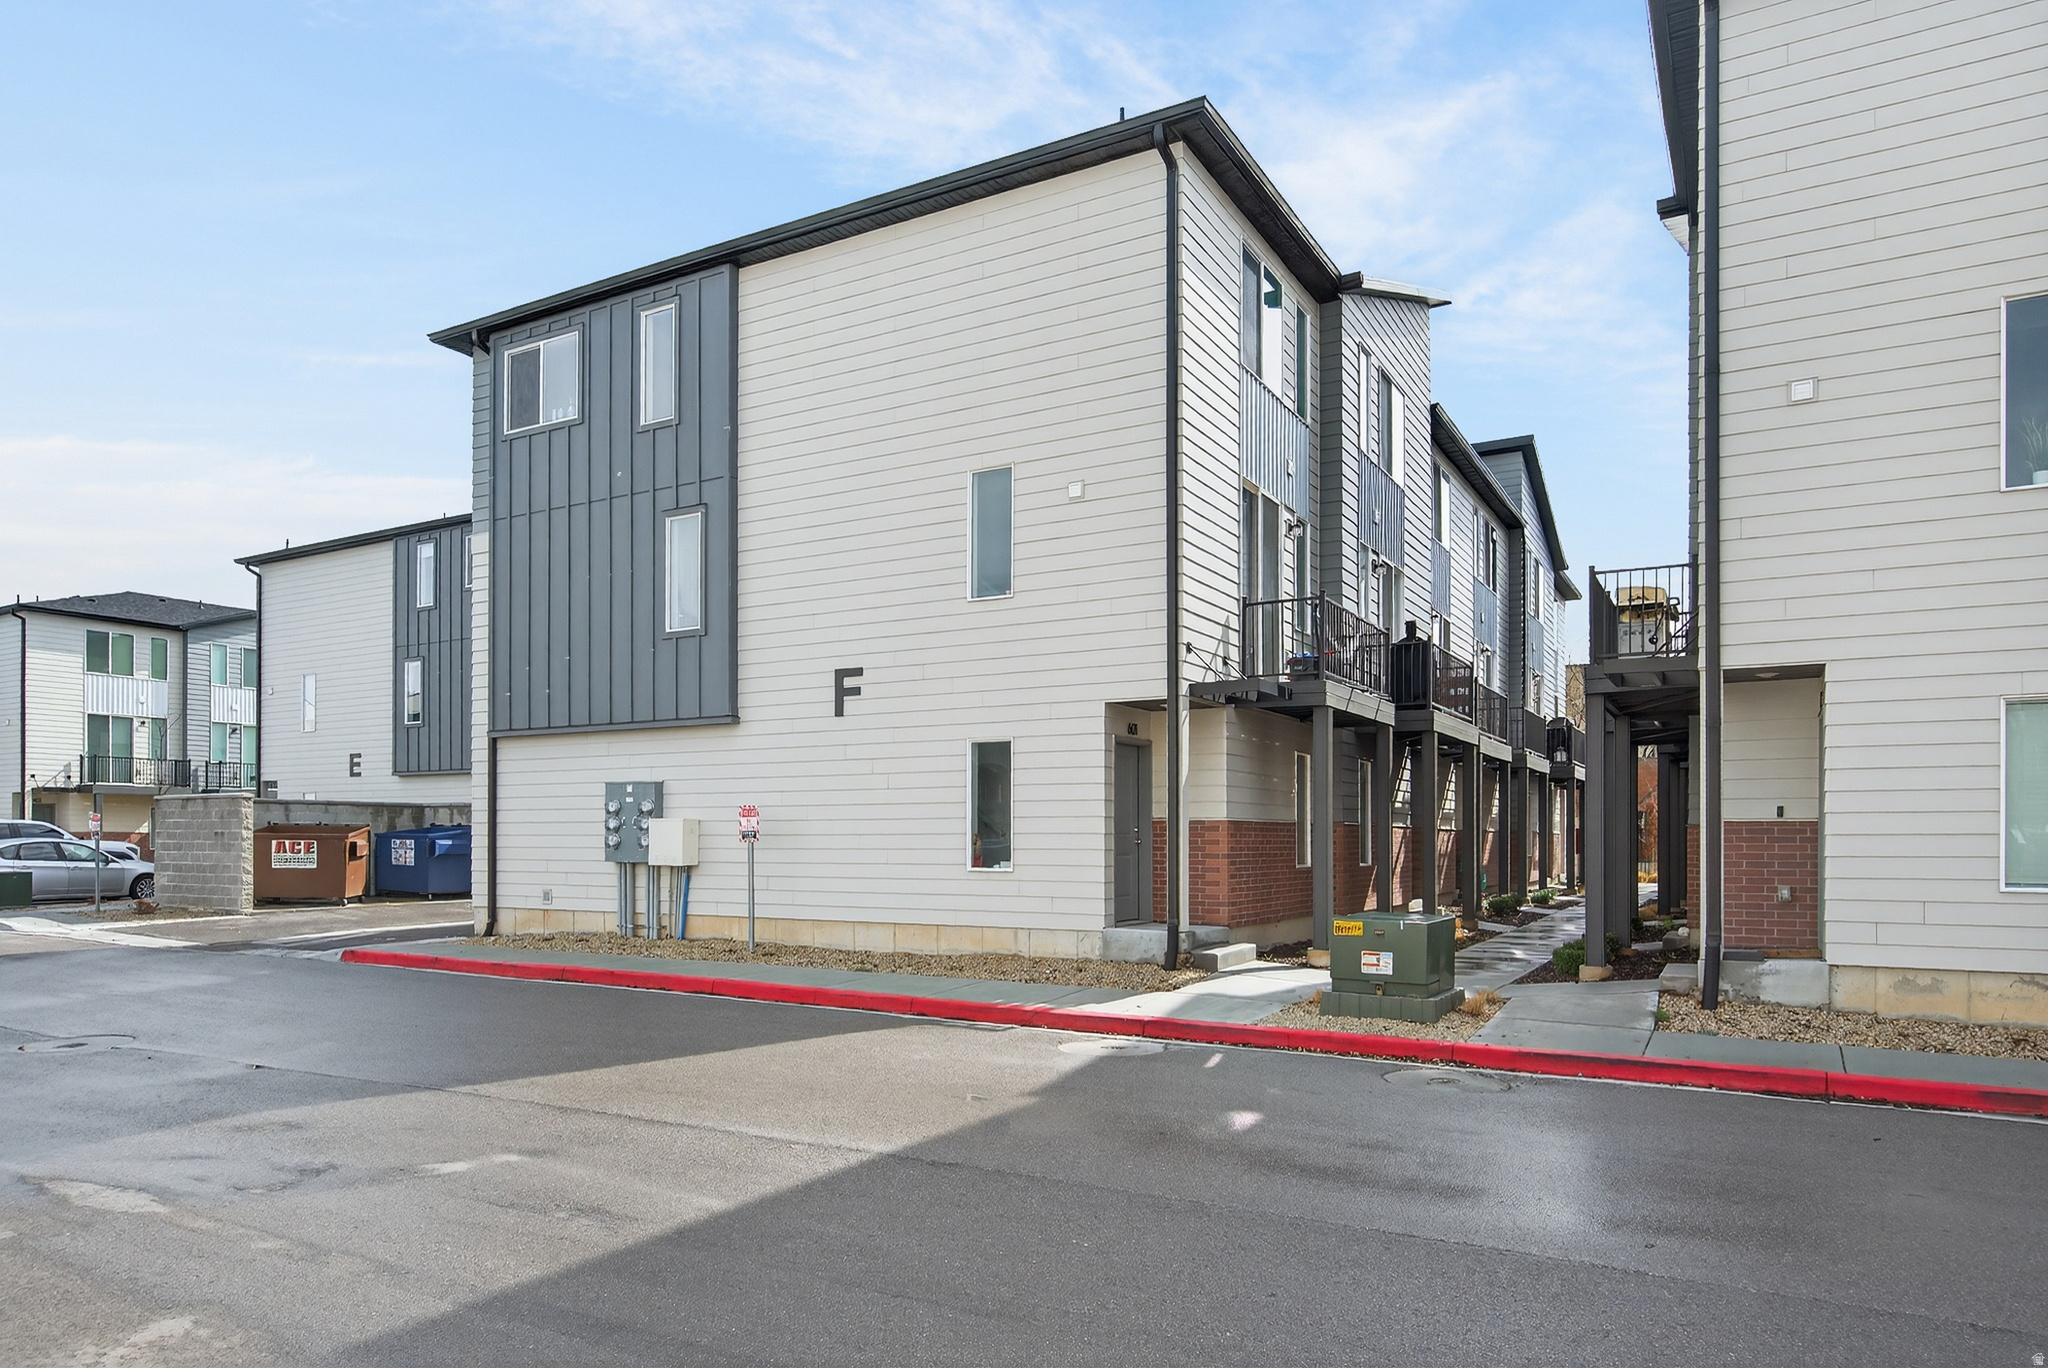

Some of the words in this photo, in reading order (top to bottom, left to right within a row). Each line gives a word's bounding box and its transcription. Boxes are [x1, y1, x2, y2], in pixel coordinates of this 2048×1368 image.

[835, 667, 863, 717] F
[350, 753, 361, 777] E
[274, 840, 315, 854] ACE
